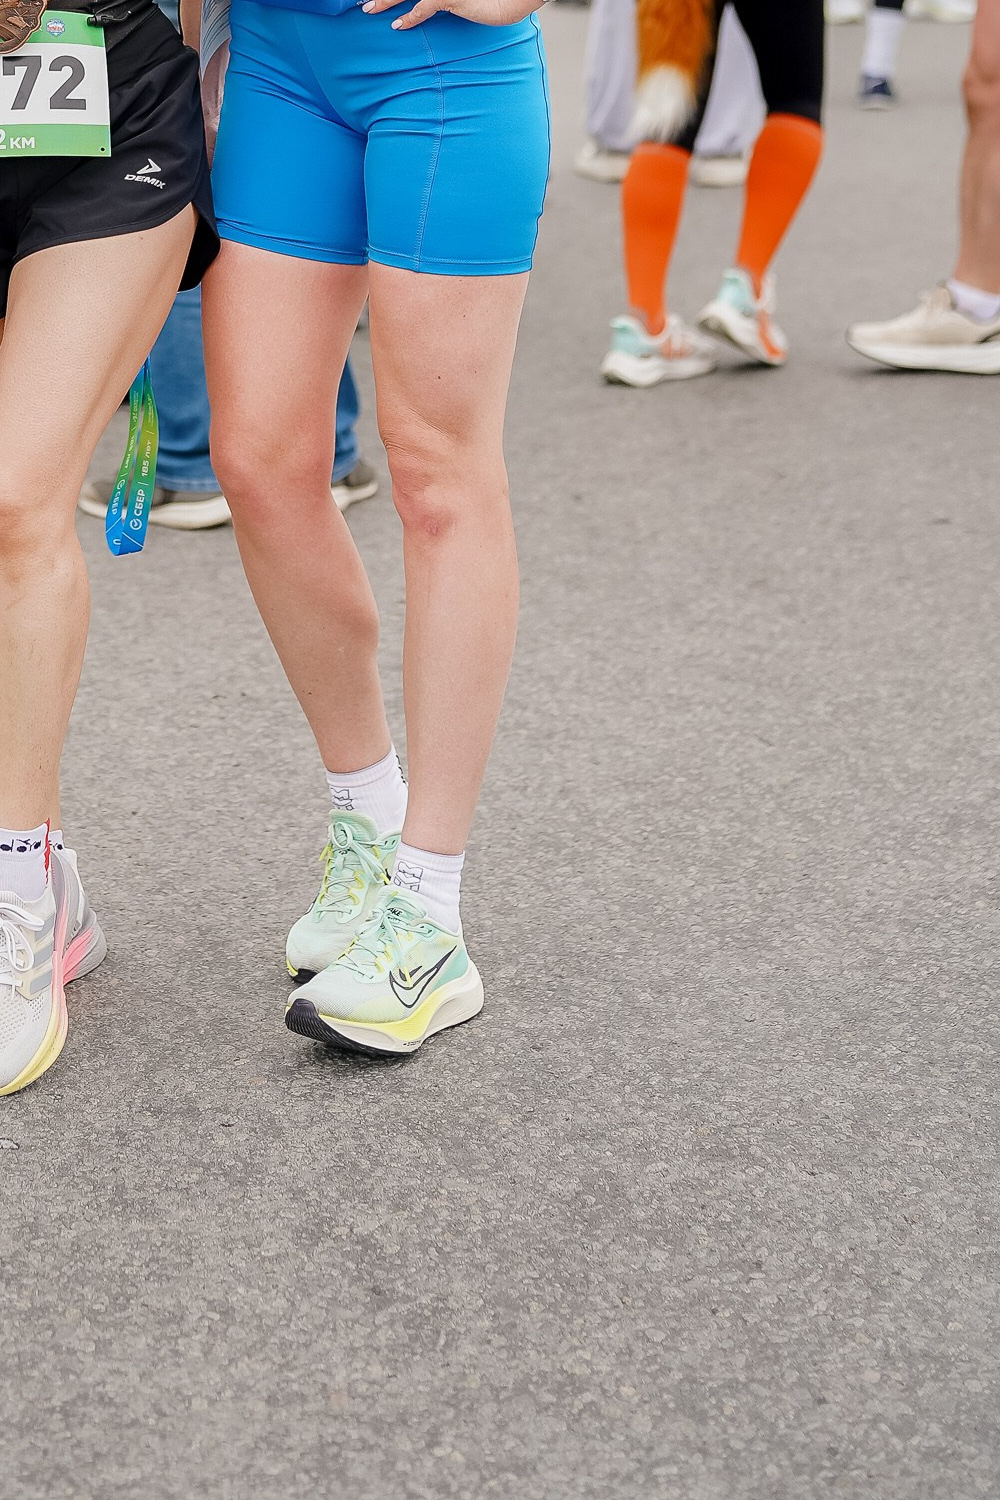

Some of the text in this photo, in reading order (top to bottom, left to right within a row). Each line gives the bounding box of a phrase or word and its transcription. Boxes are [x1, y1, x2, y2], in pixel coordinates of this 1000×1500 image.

[124, 174, 166, 189] DEMIX
[133, 489, 146, 517] СБЕР
[141, 460, 149, 477] 185
